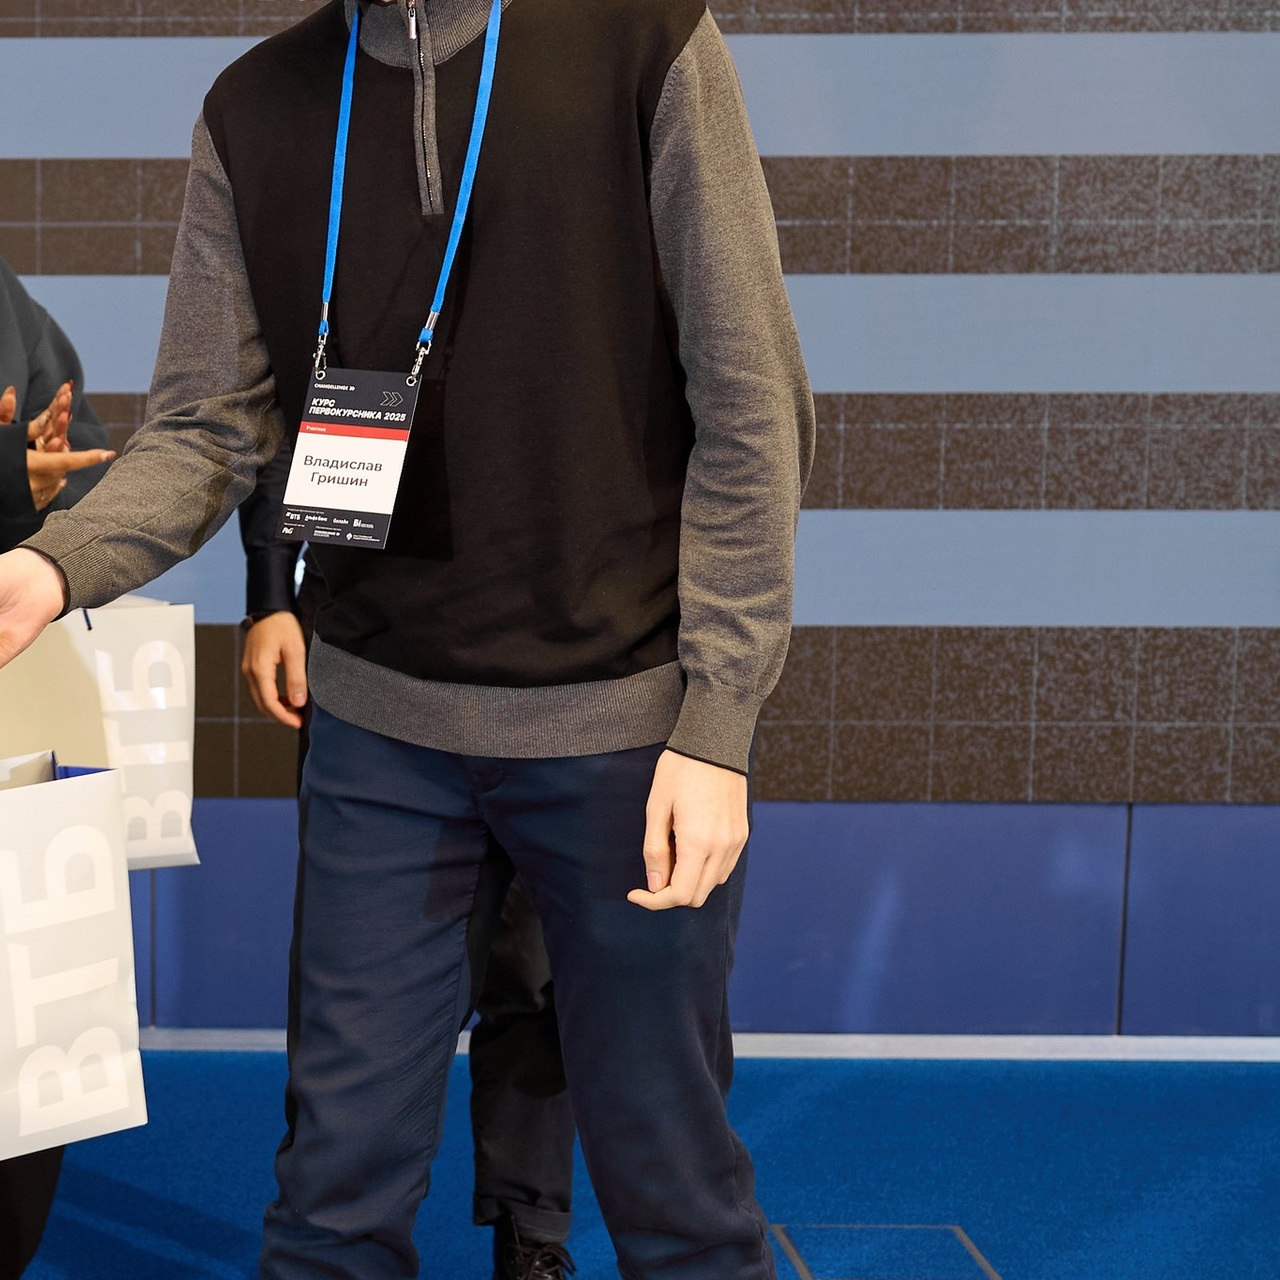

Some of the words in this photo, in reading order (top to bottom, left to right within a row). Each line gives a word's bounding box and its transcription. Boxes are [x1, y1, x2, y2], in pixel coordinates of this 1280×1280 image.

[311, 397, 336, 408] КУРС
[309, 406, 382, 420] ПЕРВОКУРСНИКА
[383, 412, 407, 422] 2025
[303, 454, 383, 472] Владислав
[310, 472, 369, 487] Гришин
[95, 640, 191, 856] ВТБ
